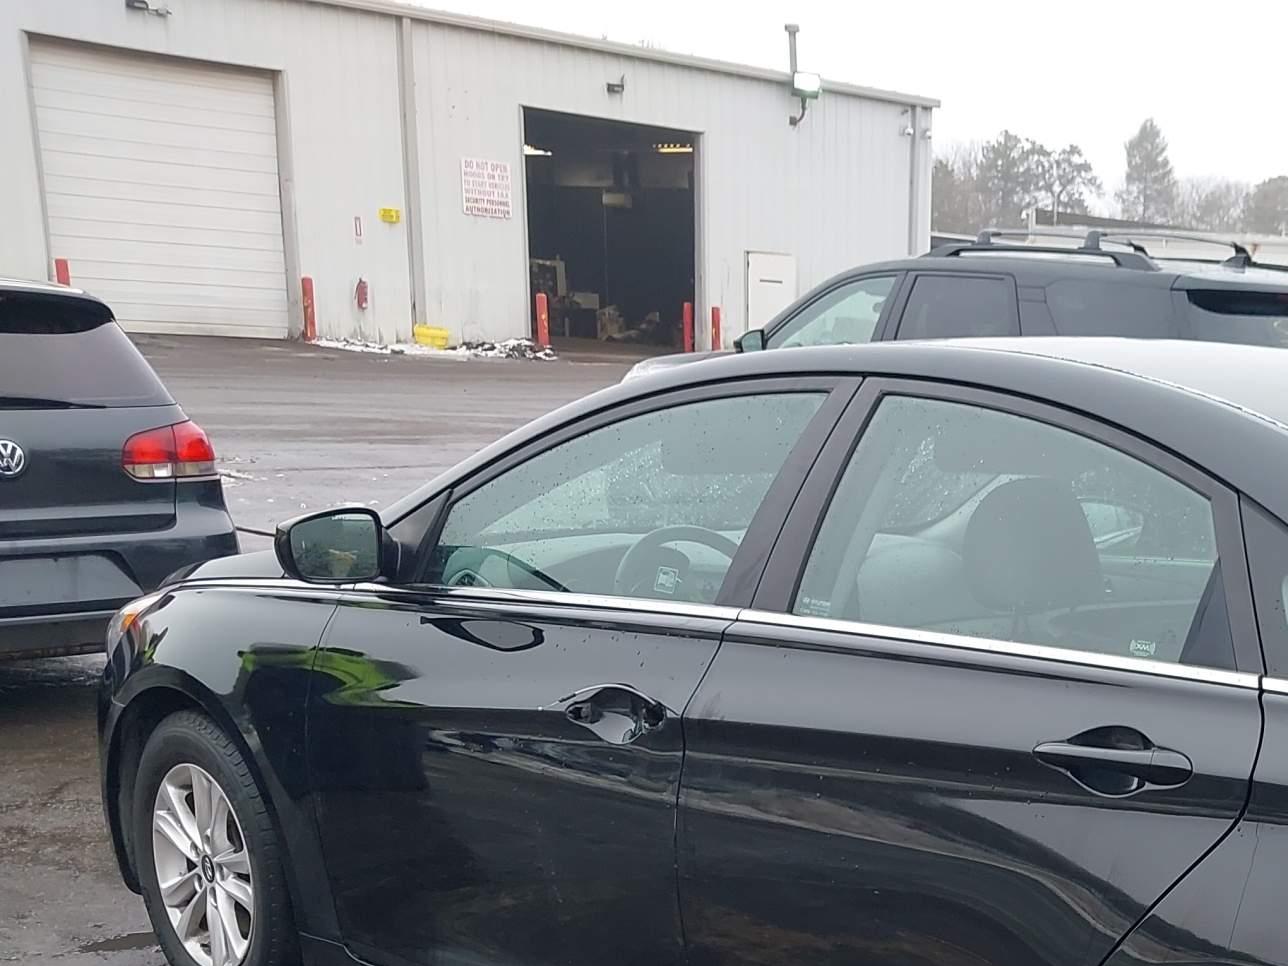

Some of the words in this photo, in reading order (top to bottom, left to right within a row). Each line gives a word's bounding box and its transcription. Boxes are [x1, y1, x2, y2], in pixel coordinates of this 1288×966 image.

[465, 160, 473, 169] DO
[476, 161, 488, 171] NOT
[491, 163, 508, 173] OPEN
[498, 174, 509, 182] TRY
[464, 187, 495, 197] WITHOUT
[465, 196, 485, 204] SECURITY
[486, 199, 510, 208] PERSONNEL
